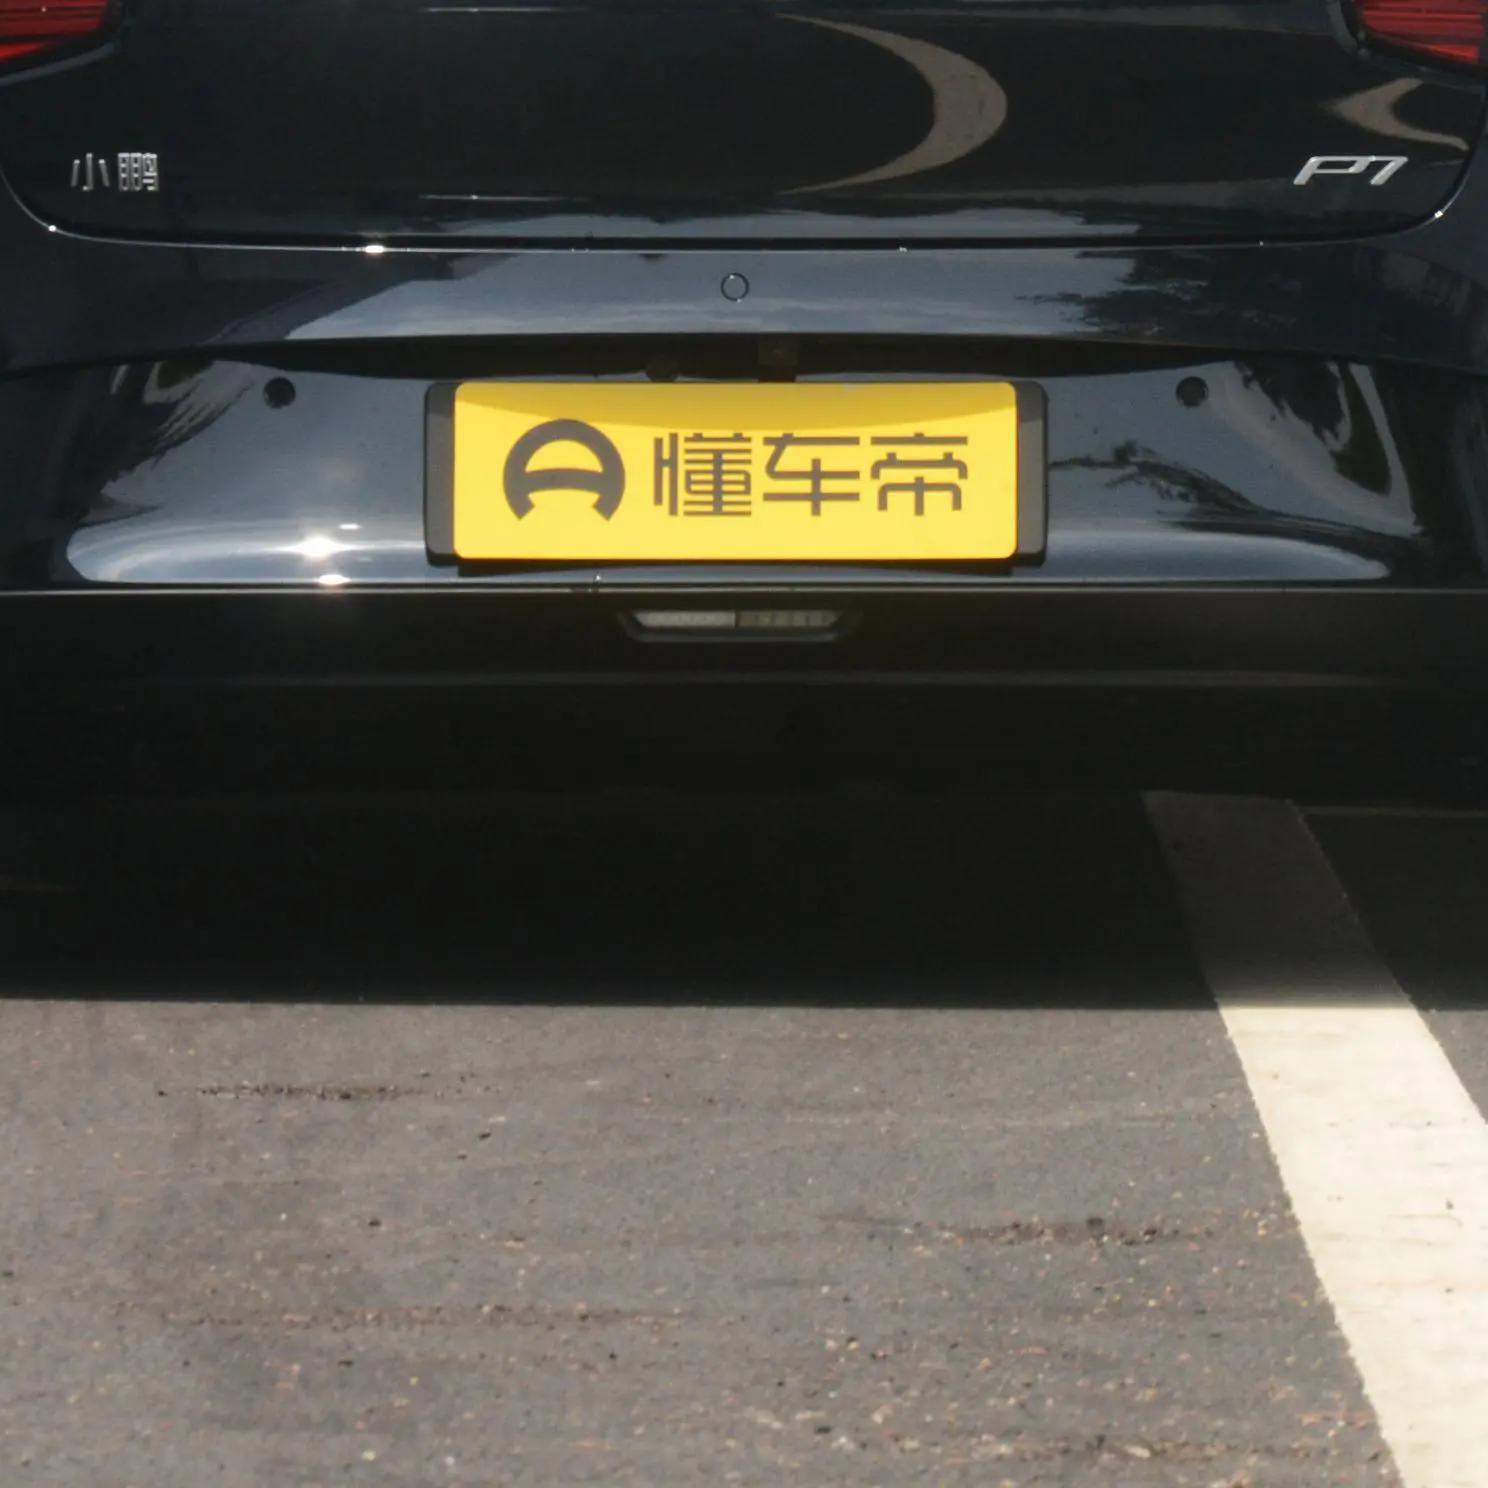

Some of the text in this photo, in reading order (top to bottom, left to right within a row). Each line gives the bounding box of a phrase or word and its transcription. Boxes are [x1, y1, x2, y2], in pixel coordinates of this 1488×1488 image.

[70, 152, 160, 192] 小鹏
[1292, 155, 1409, 186] P7
[653, 432, 968, 517] 懂车帝
